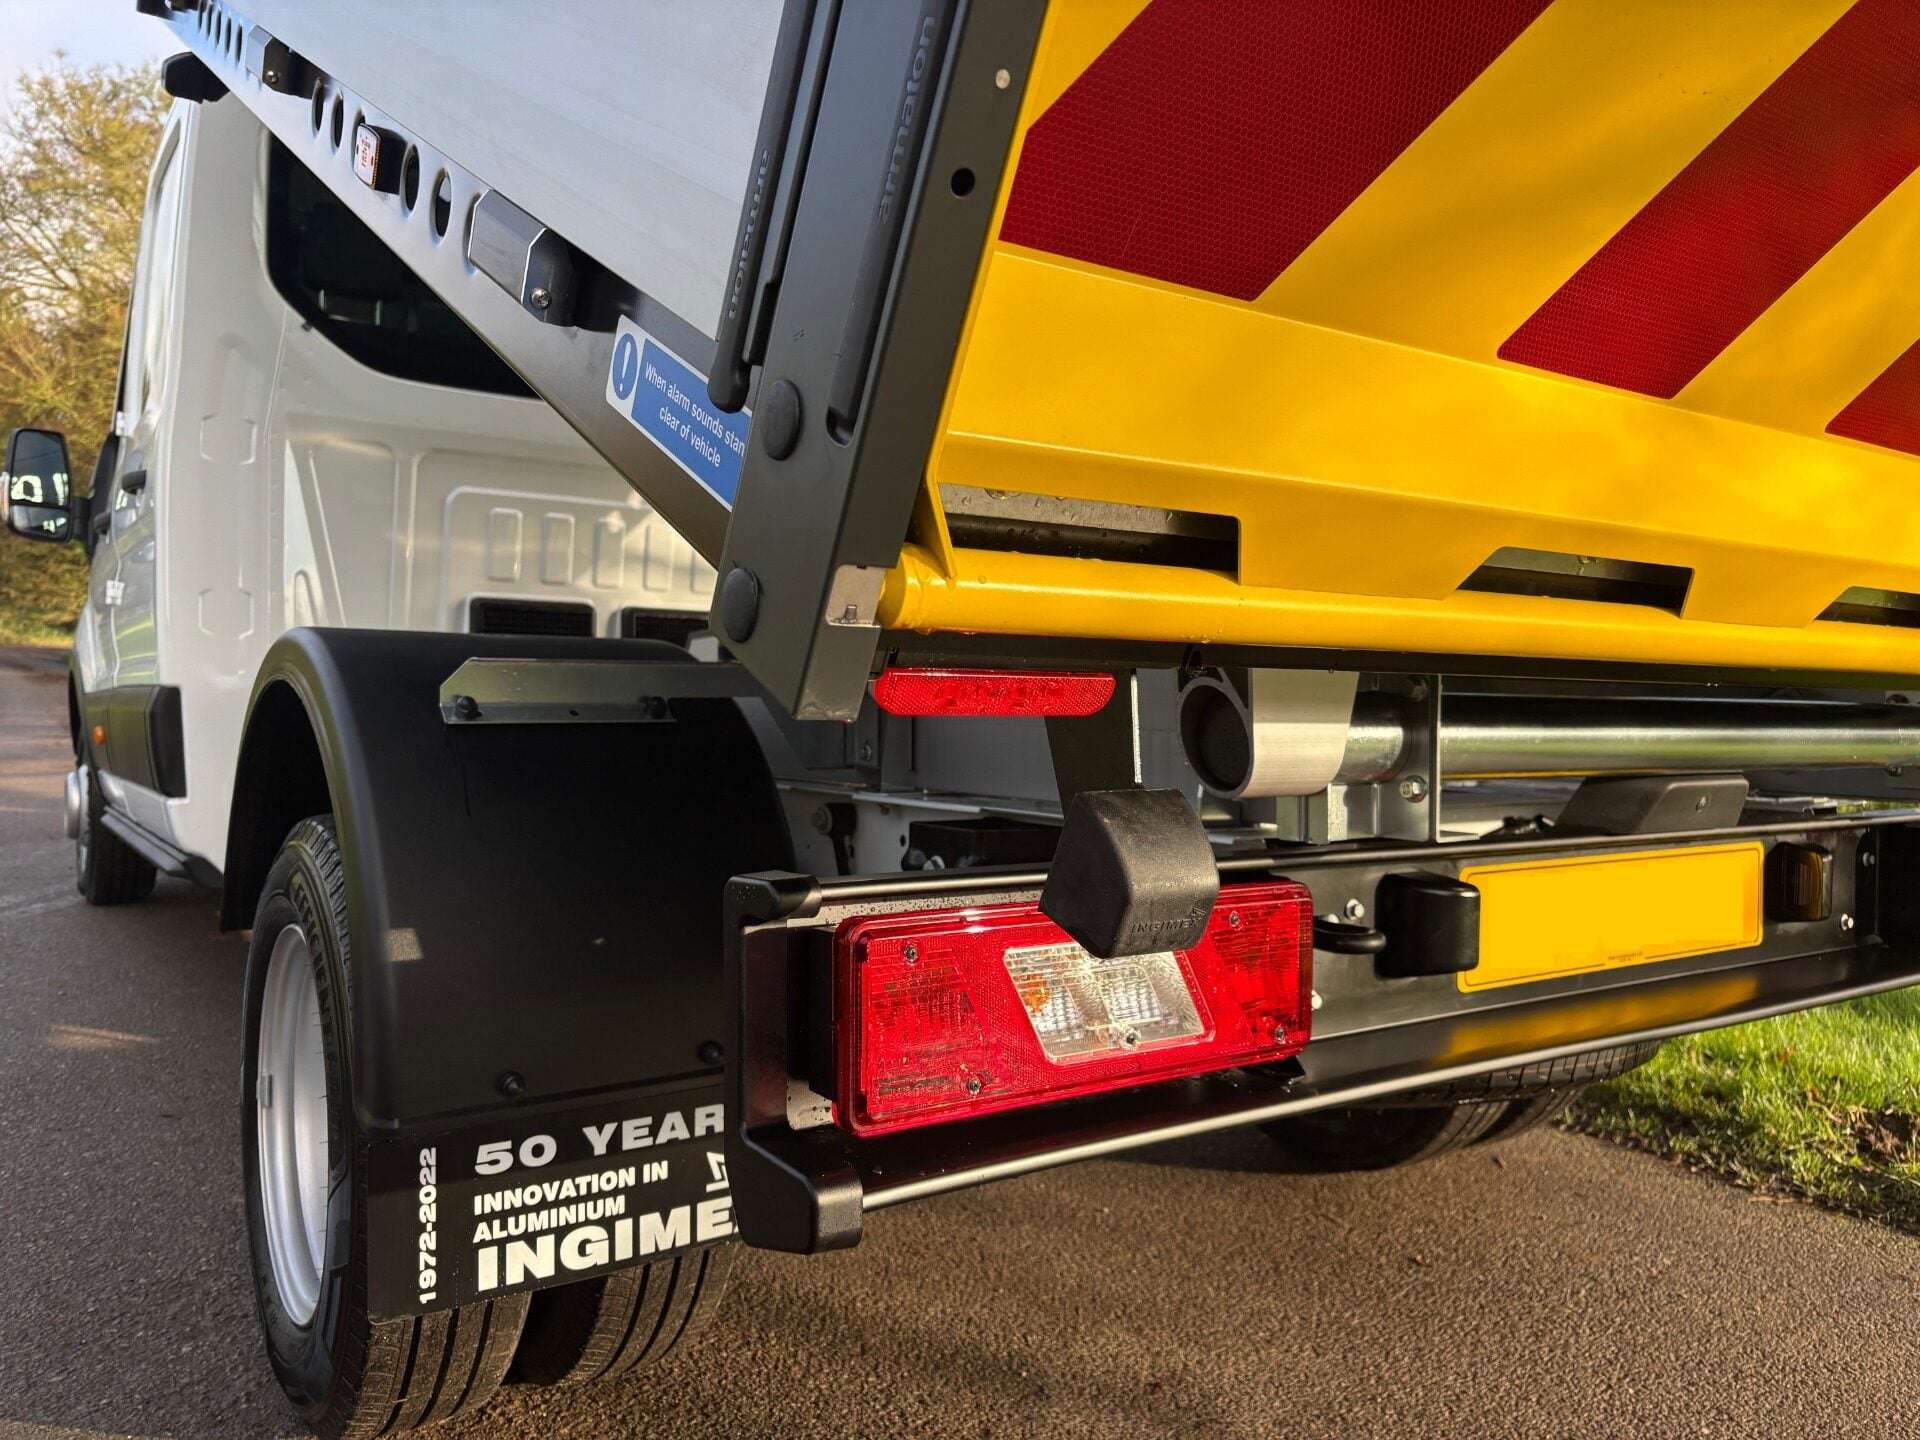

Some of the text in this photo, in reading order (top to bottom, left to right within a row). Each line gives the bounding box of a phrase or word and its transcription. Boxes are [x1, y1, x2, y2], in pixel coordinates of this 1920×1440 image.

[645, 361, 745, 457] When alarm sounds stan
[659, 406, 721, 467] clear of vehicle
[474, 1103, 725, 1175] 50 YEAR
[472, 1195, 626, 1244] ALUMINIUM
[474, 1160, 669, 1215] INNOVATION IN
[419, 1146, 437, 1304] 1972-2022
[477, 1195, 737, 1292] INGIME
